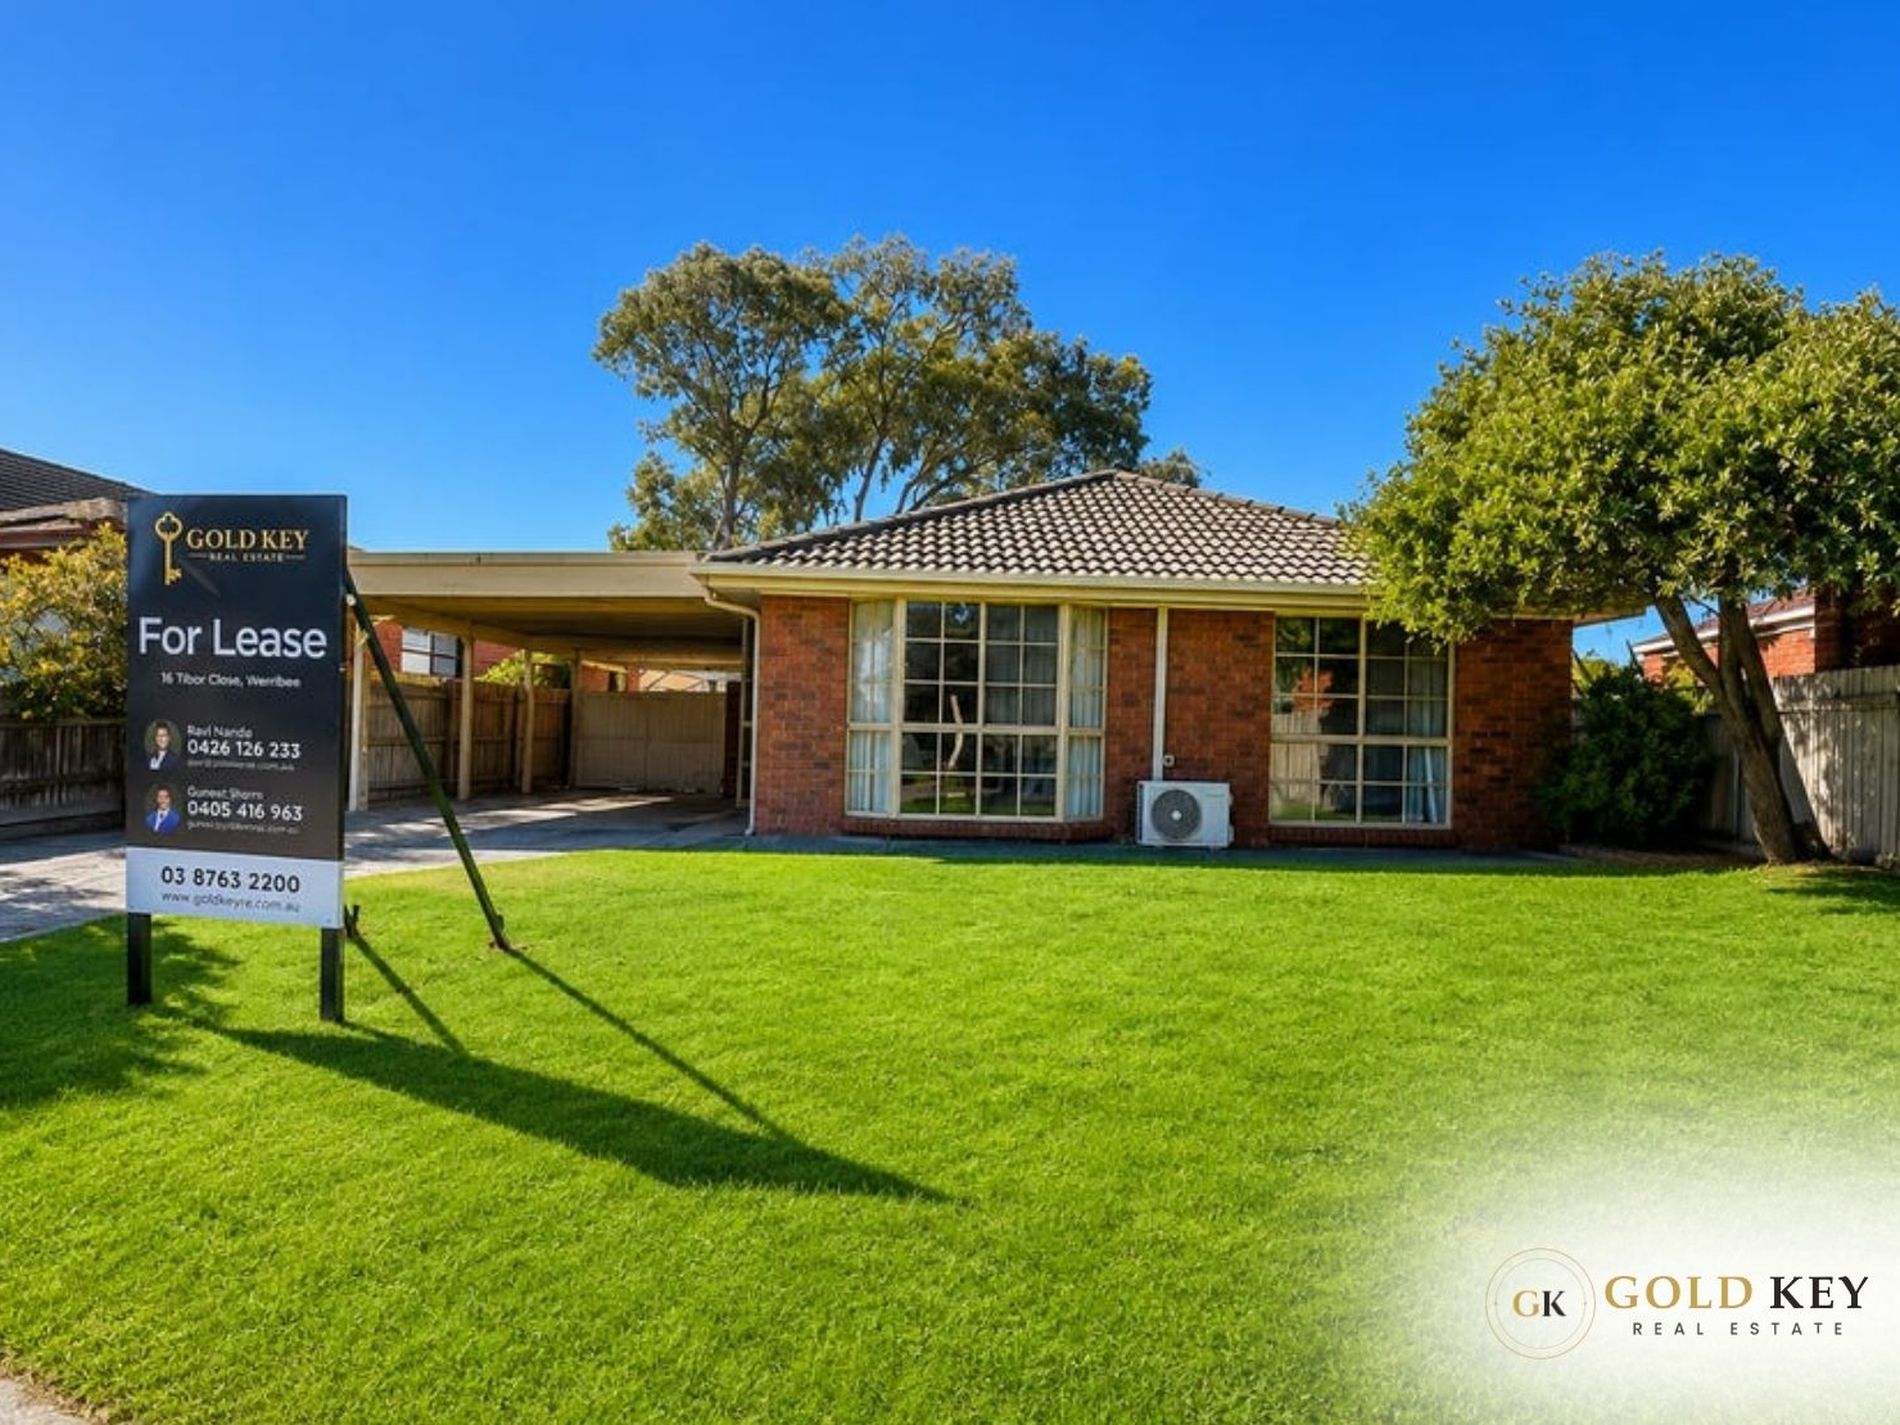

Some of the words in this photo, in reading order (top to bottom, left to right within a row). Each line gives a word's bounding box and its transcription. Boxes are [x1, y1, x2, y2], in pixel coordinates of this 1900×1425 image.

[187, 529, 256, 549] GOLD
[262, 530, 309, 551] KEY
[209, 552, 238, 562] REAL
[243, 552, 284, 563] ESTATE
[138, 616, 203, 655] For
[213, 618, 327, 658] Lease
[187, 739, 231, 756] 0426
[236, 741, 264, 758] 126
[269, 742, 301, 759] 233
[187, 801, 231, 817] 0405
[236, 803, 265, 819] 416
[270, 805, 303, 821] 963
[161, 866, 185, 885] 03
[192, 868, 241, 889] 8763
[249, 872, 300, 893] 2200
